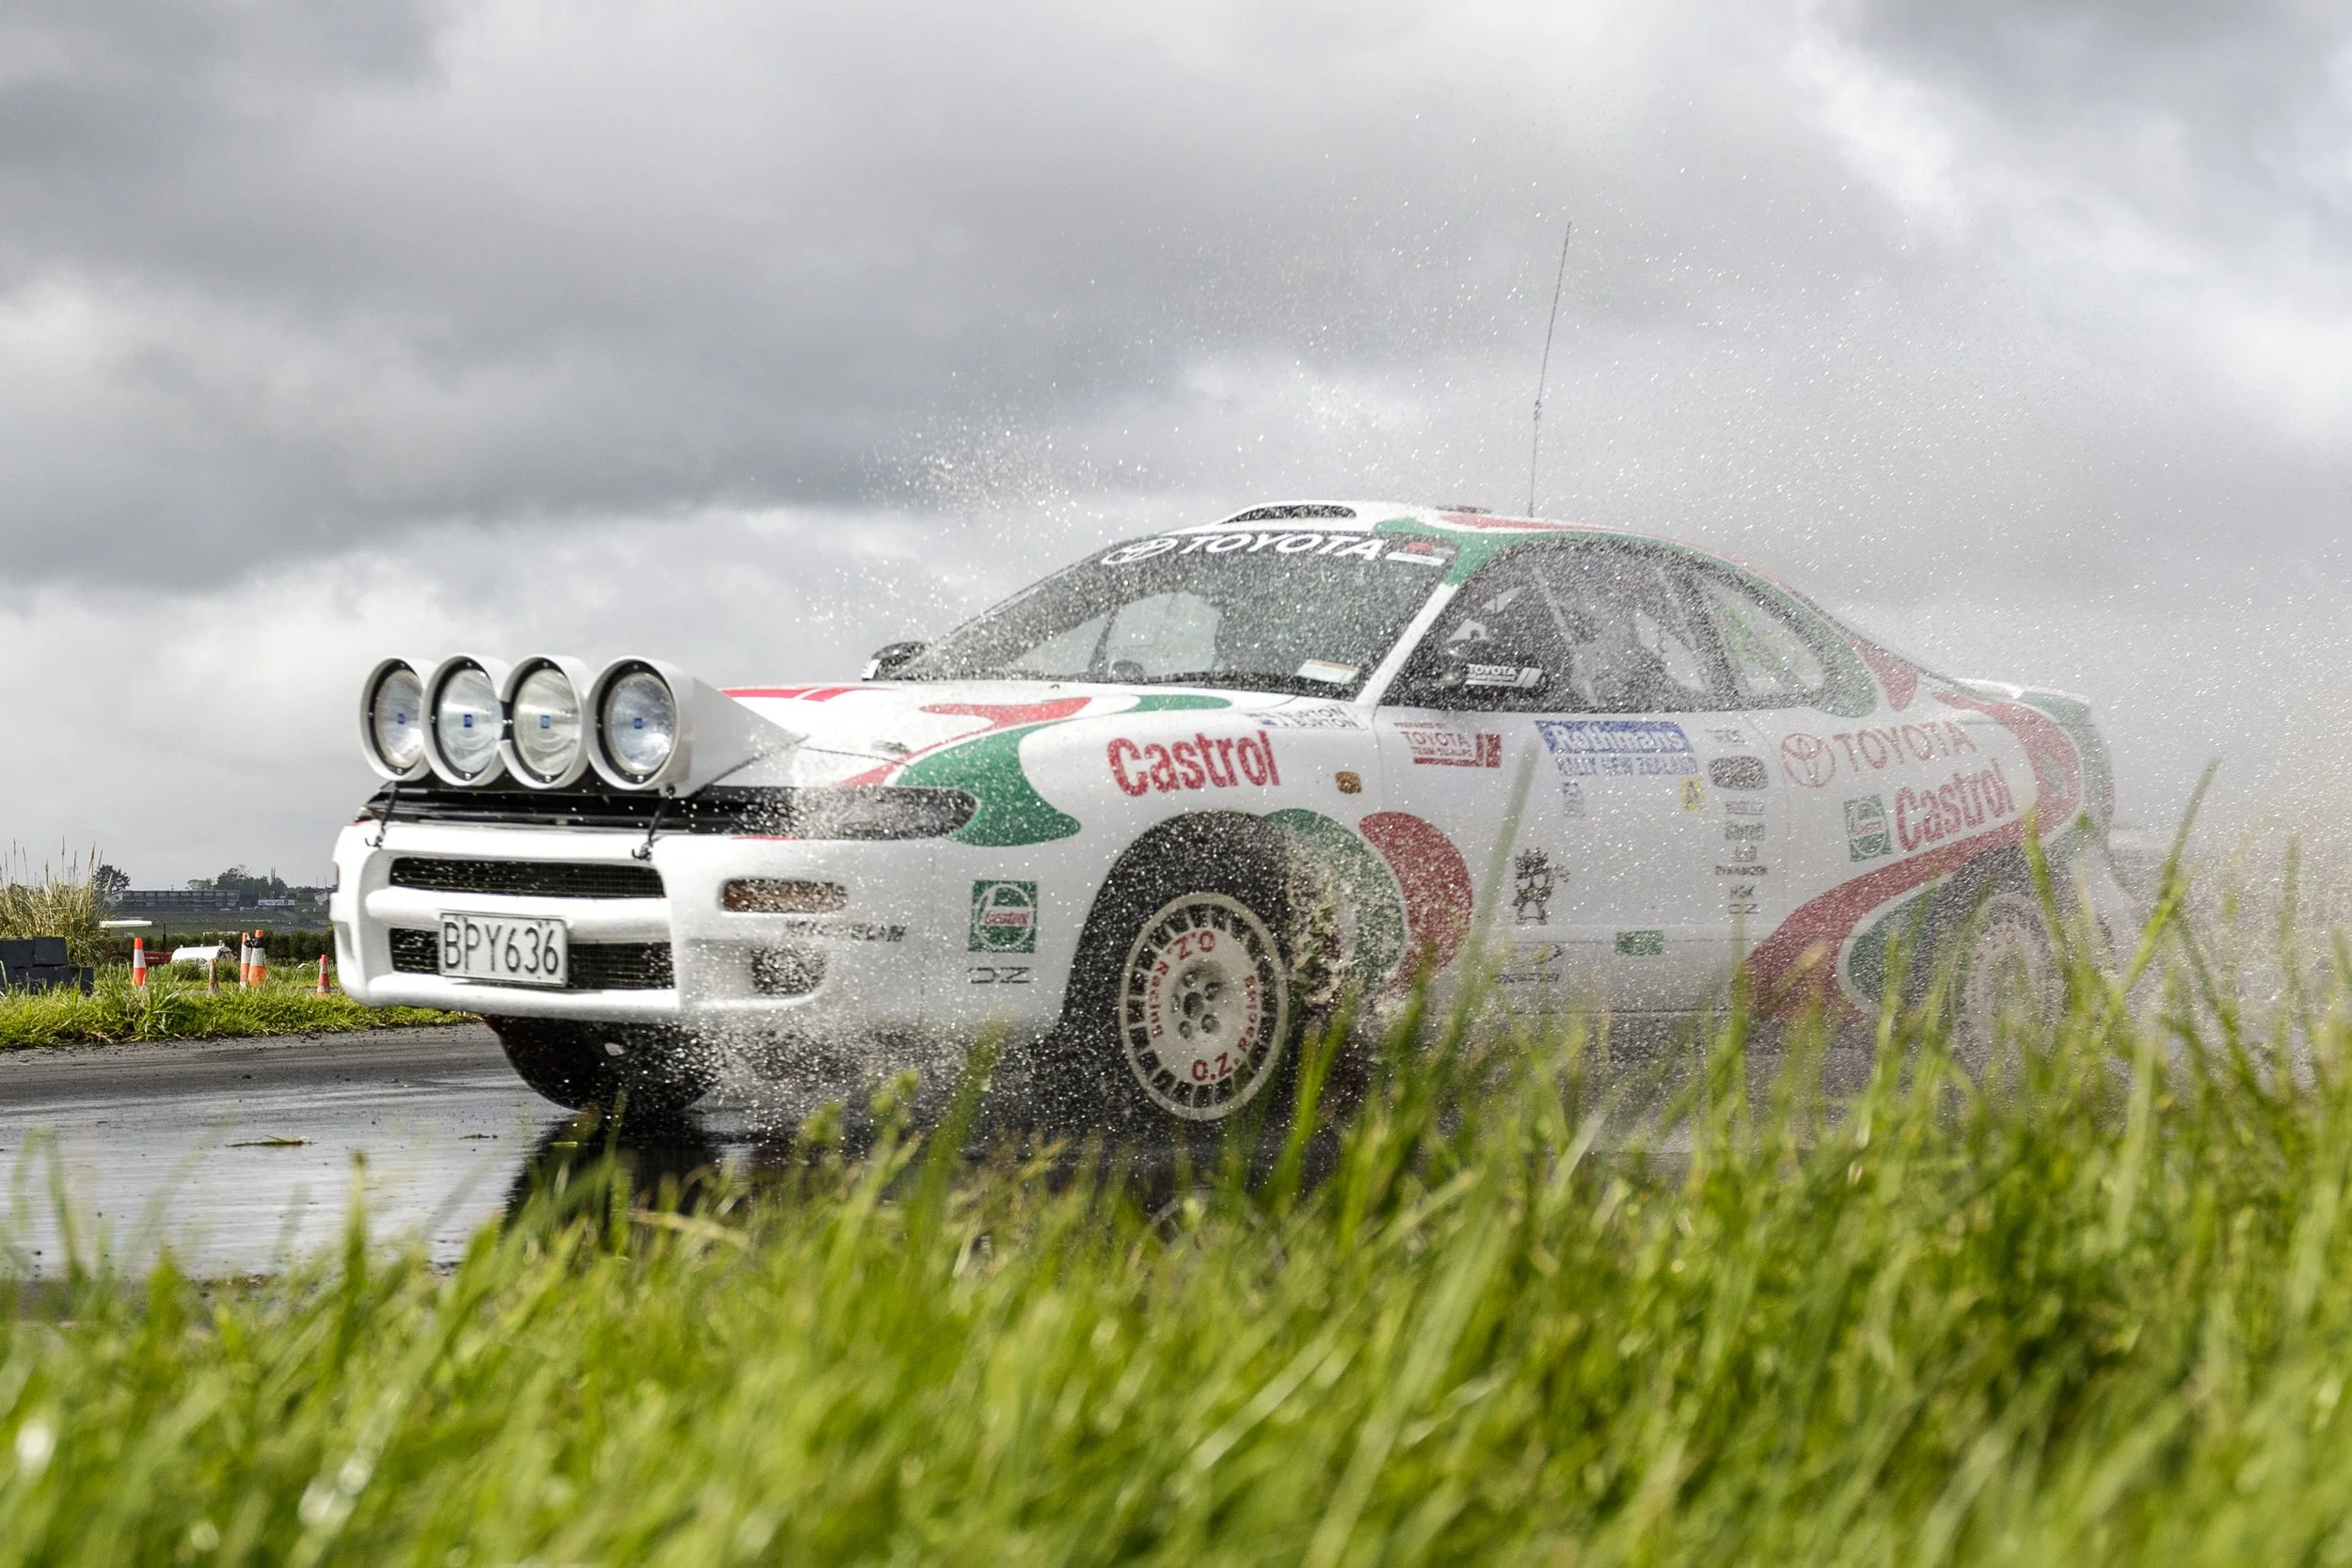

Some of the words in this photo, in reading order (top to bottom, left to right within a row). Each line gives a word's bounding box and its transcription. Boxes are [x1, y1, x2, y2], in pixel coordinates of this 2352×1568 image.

[1180, 533, 1387, 561] TOYOTA
[1467, 663, 1518, 675] TOYOTA
[1400, 731, 1471, 748] TOYOTA
[1549, 721, 1686, 752] Rothmans
[1833, 721, 1978, 772] TOYOTA
[1107, 730, 1280, 797] Castrol
[1895, 757, 2016, 851] Castrol
[444, 922, 559, 975] BPY636
